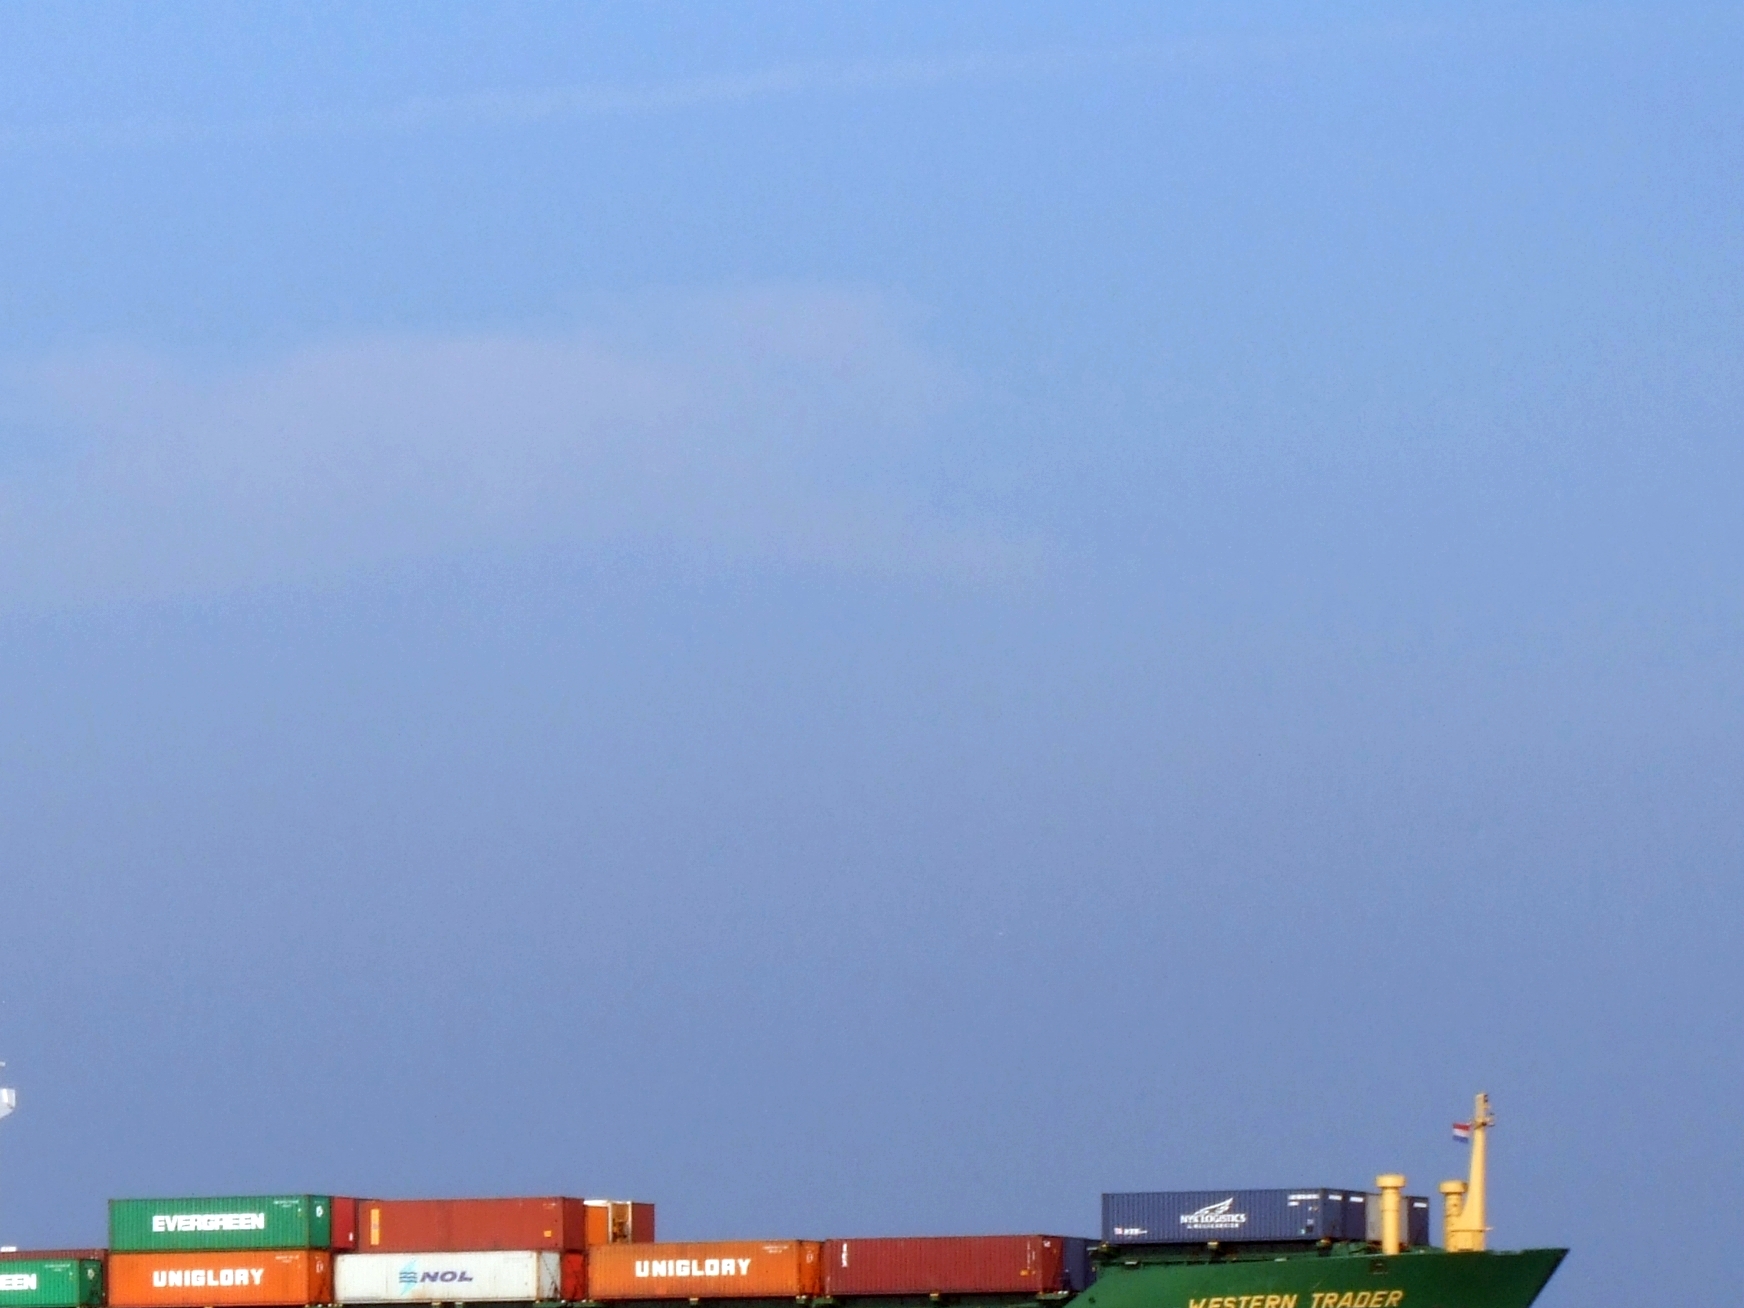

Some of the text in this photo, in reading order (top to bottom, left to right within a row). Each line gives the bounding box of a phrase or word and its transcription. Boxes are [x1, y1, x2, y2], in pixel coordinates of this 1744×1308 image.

[152, 1212, 265, 1232] EVERGREEN
[420, 1271, 473, 1282] NOL
[635, 1259, 751, 1277] UNIGLORY
[153, 1268, 264, 1287] UNIGLORY
